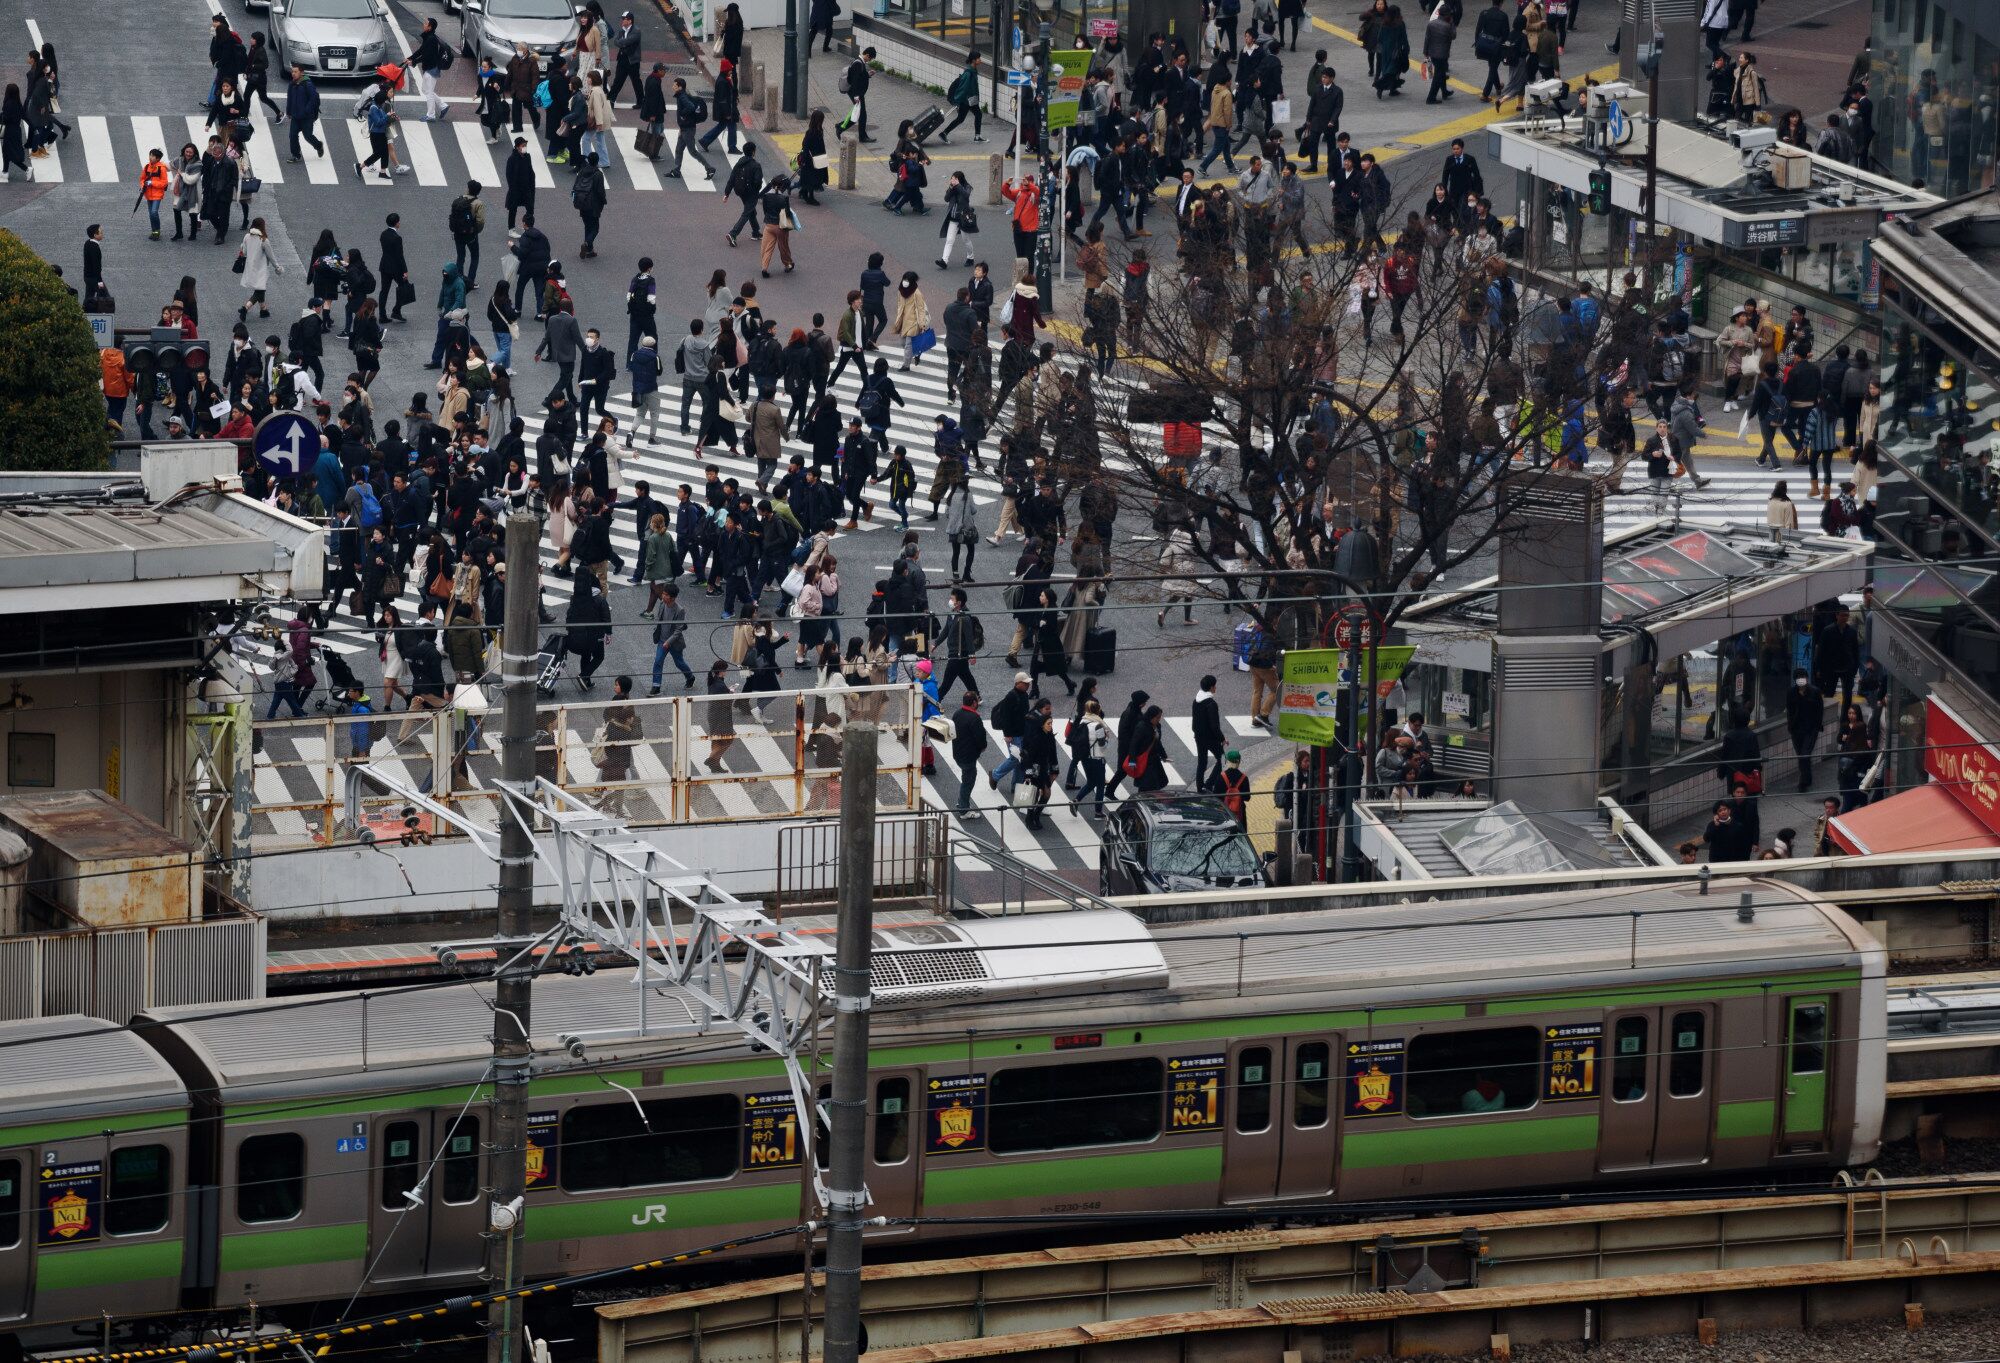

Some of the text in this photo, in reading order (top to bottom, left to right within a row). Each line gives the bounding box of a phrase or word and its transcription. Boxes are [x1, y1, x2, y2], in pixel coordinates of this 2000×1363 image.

[1747, 231, 1777, 243] 渋谷駅
[91, 319, 107, 334] 前
[1340, 627, 1371, 643] 消栓
[1293, 665, 1329, 675] SHIBUYA
[1376, 661, 1404, 671] HIBUYA
[1550, 1047, 1595, 1095] No.1
[1552, 1063, 1574, 1075] 仲介
[1363, 1084, 1385, 1098] No.1
[760, 1094, 795, 1103] 住友不動産販
[1173, 1078, 1218, 1126] No.1
[1174, 1094, 1196, 1106] 仲介
[356, 1123, 362, 1134] 1
[944, 1119, 967, 1133] No.1
[750, 1114, 796, 1164] No.1
[752, 1130, 774, 1143] 仲介
[46, 1153, 56, 1164] 2
[57, 1208, 82, 1223] No.1
[631, 1204, 667, 1226] JR
